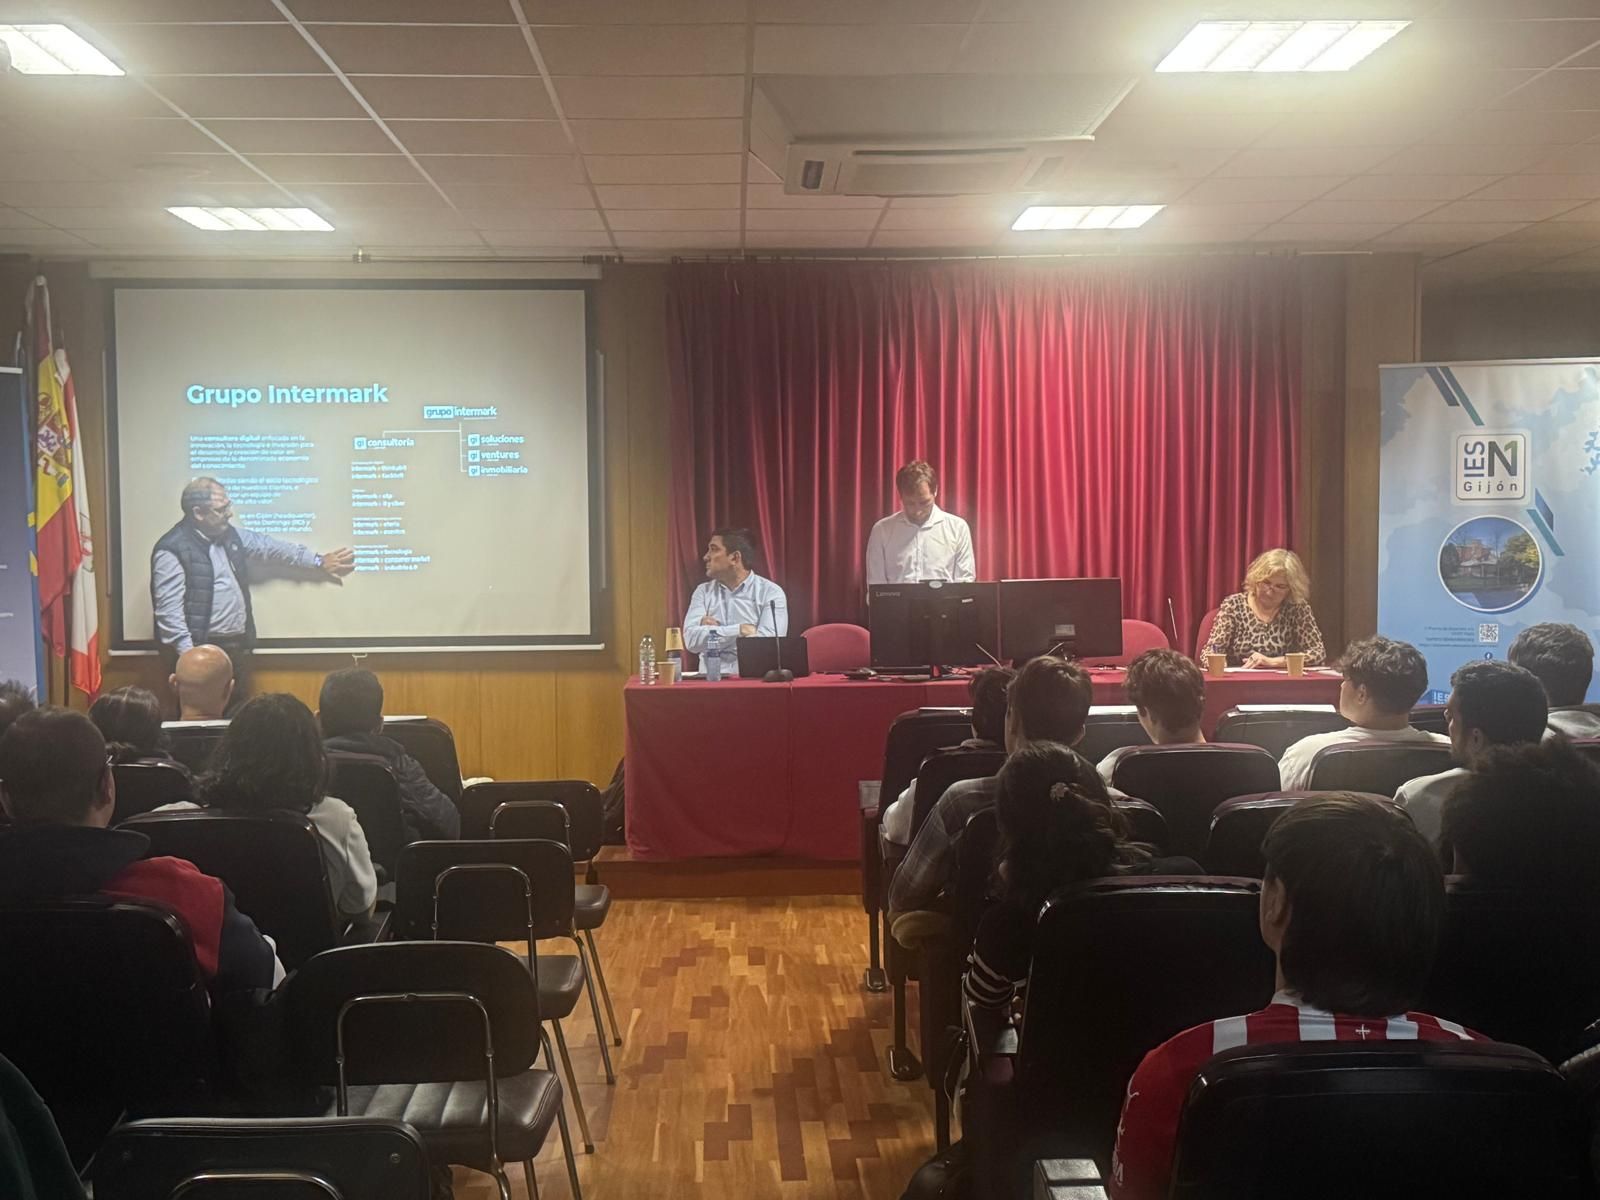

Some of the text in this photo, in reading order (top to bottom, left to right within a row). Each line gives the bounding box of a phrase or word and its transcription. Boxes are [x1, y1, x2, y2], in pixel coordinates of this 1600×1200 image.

[186, 383, 389, 408] Grupo Intermark
[426, 406, 497, 418] grupo intermark
[480, 434, 525, 444] soluciones
[481, 451, 520, 460] ventures
[1463, 440, 1485, 478] IES
[481, 465, 528, 474] inmobiliaria
[1463, 480, 1519, 493] Gijón
